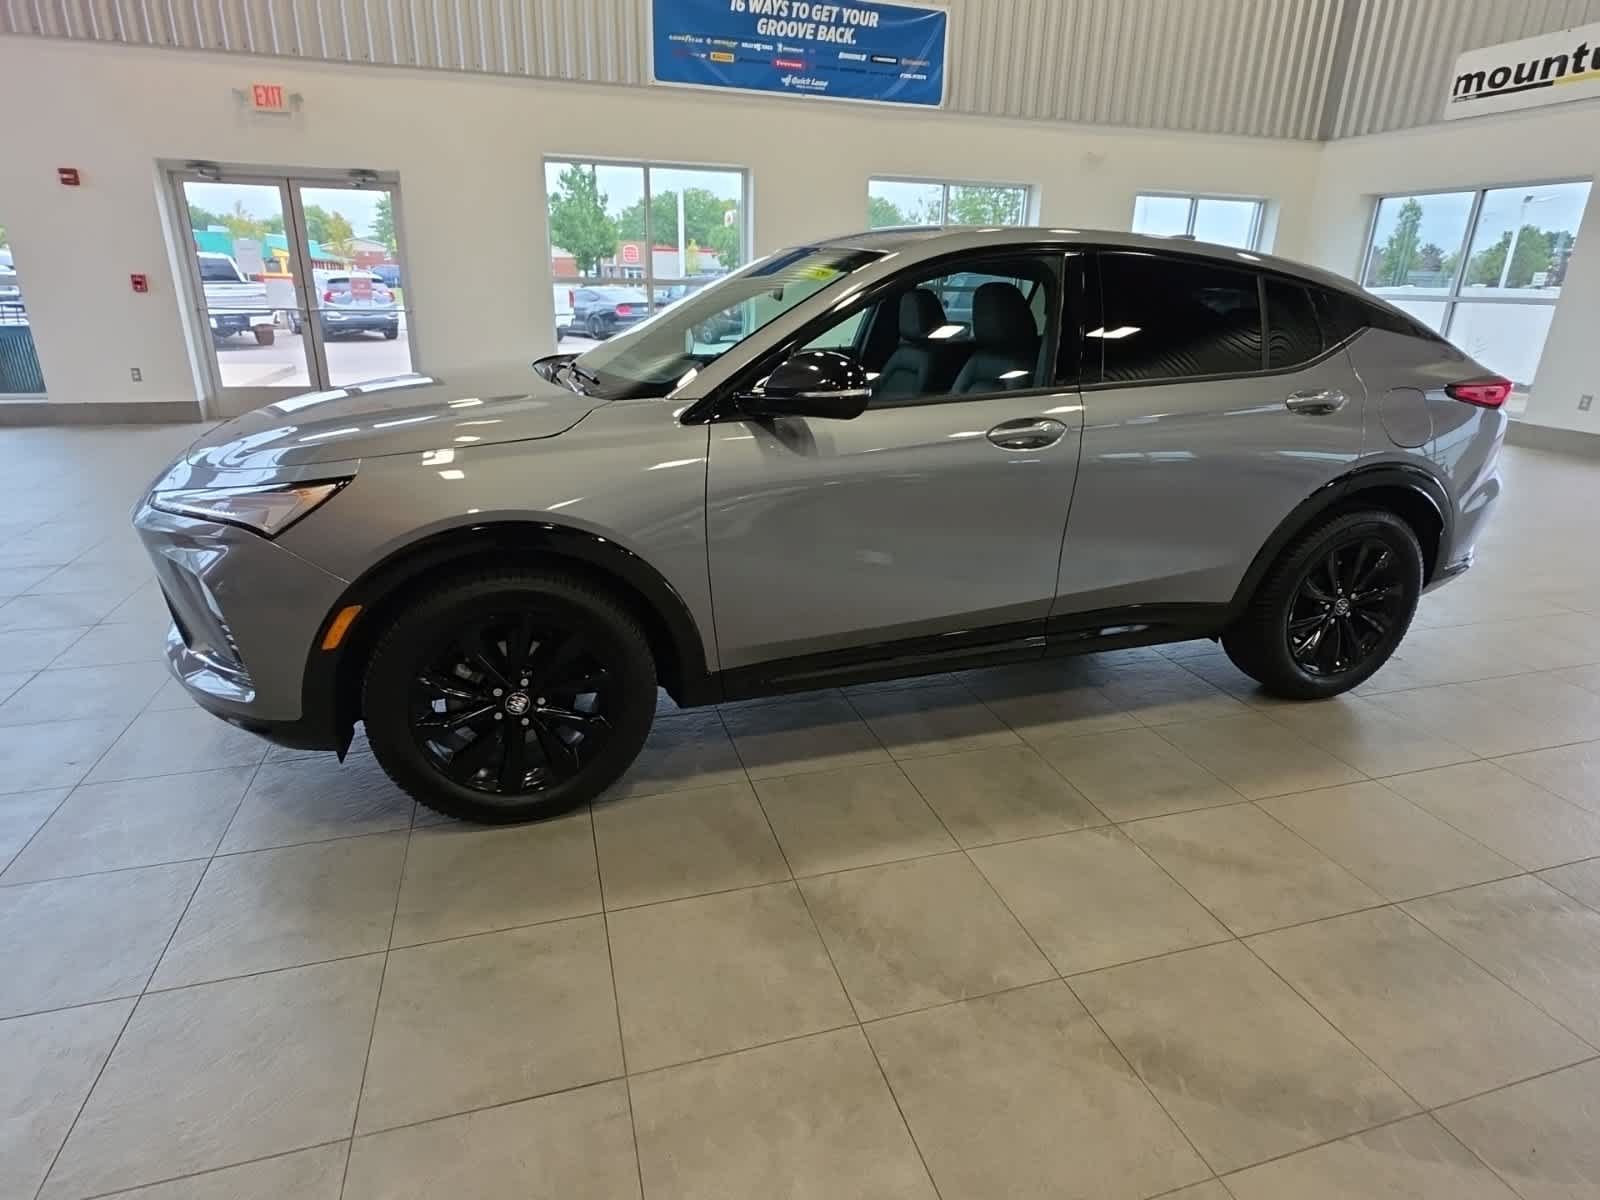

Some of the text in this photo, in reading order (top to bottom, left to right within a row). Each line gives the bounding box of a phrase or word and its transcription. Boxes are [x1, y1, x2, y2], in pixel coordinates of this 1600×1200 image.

[730, 0, 879, 27] 16 WAYS TO GET YOUR
[757, 18, 857, 45] GROOVE BACK.
[253, 85, 282, 108] EXIT
